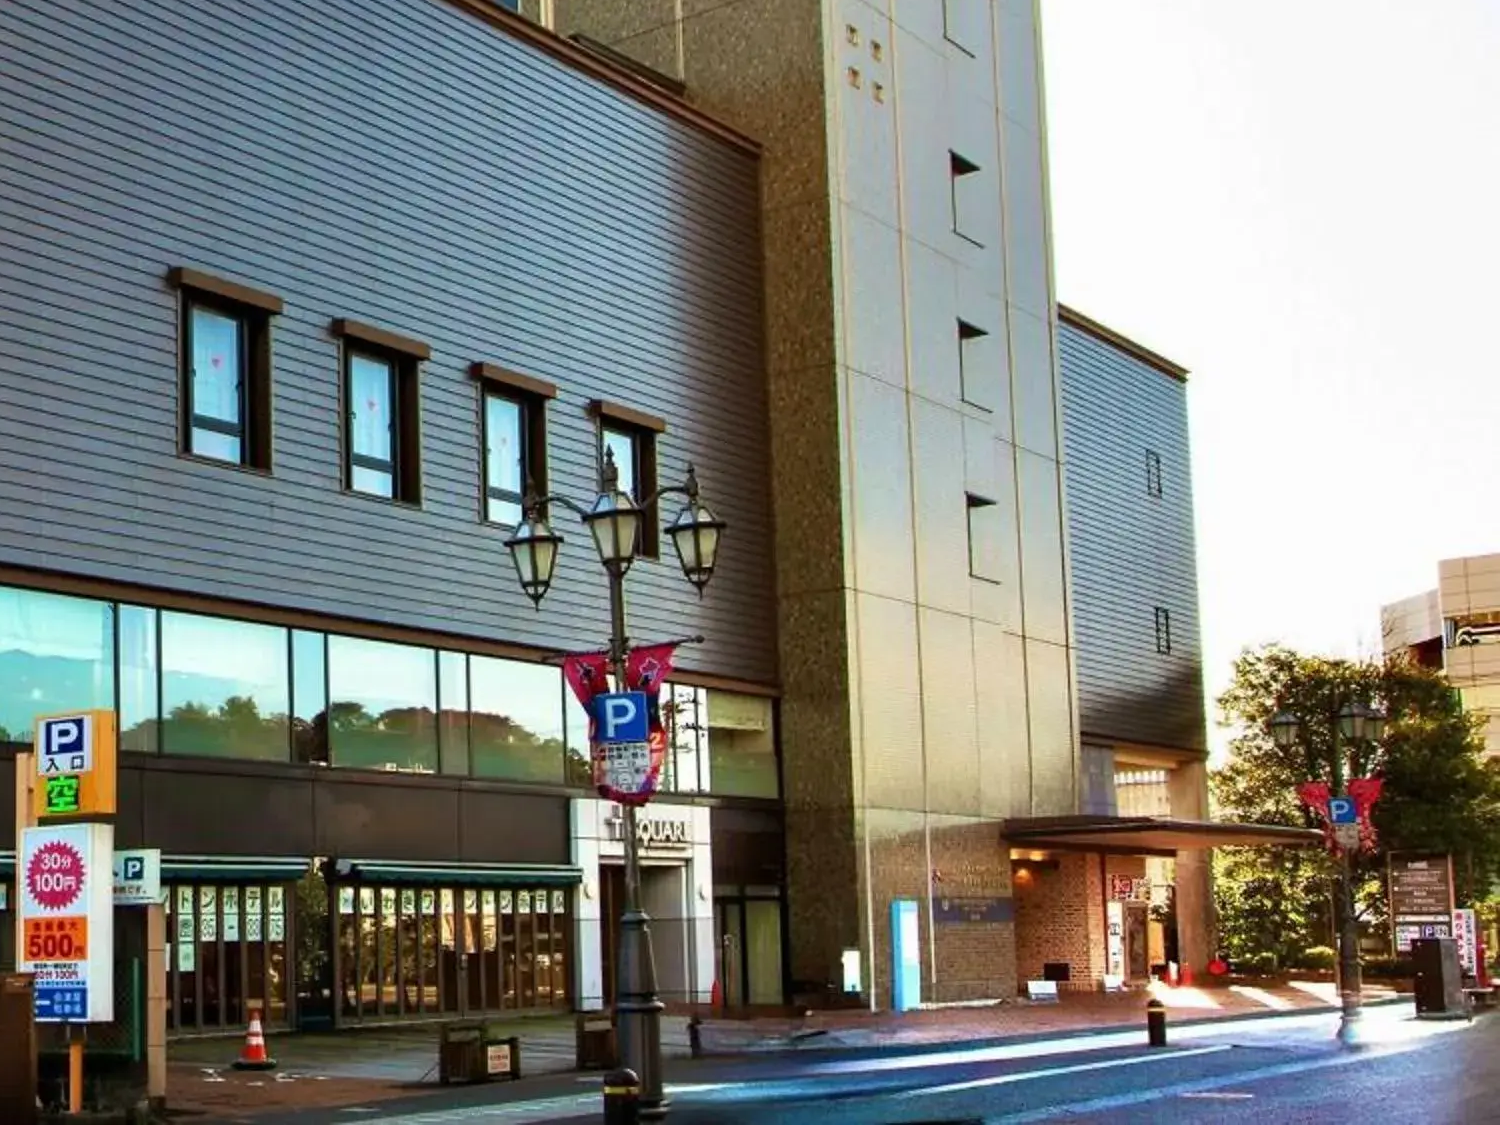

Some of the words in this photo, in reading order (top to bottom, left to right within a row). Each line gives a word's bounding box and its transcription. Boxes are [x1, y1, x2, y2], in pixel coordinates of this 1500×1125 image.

[605, 698, 636, 738] P
[51, 722, 79, 752] P
[46, 756, 84, 772] 入口
[46, 774, 79, 812] 空
[1331, 800, 1349, 822] P
[41, 852, 72, 870] 30分
[127, 861, 141, 878] P
[34, 872, 77, 892] 100円
[28, 934, 85, 958] 500円
